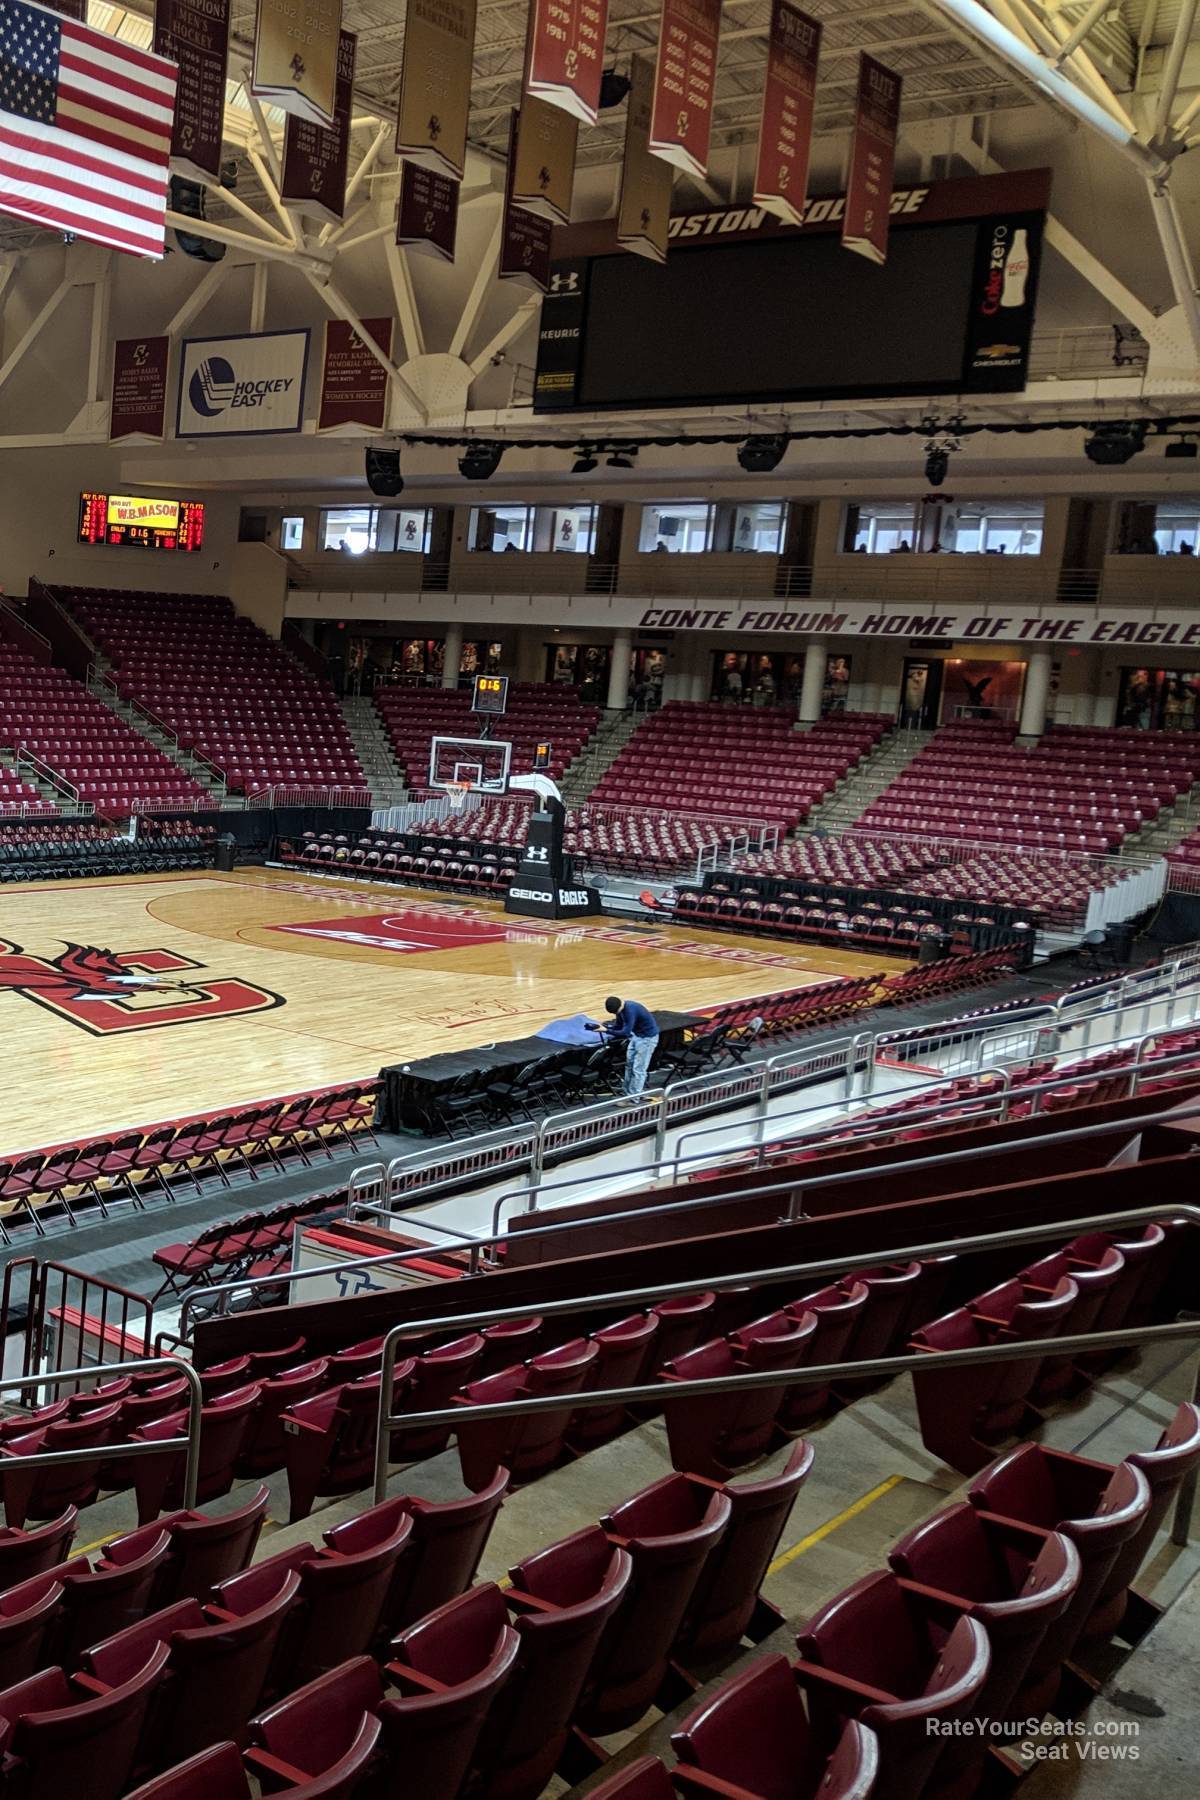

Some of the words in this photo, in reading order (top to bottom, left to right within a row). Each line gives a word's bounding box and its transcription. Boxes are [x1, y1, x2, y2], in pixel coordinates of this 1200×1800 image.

[173, 20, 213, 48] HOCKEY
[546, 22, 566, 41] 1981
[779, 9, 816, 49] SWEET
[871, 68, 895, 99] ELITE
[667, 209, 768, 238] OSTON
[991, 226, 1006, 270] zero
[981, 268, 1001, 315] Coke
[541, 327, 580, 339] KEURIG
[235, 378, 293, 395] HOCKEY
[231, 394, 266, 408] EAST
[638, 609, 732, 630] CONTE
[737, 611, 849, 632] FORUM
[859, 614, 957, 636] HOME
[963, 617, 1012, 638] OF
[1018, 618, 1084, 640] THE
[509, 887, 553, 903] GEICO
[558, 888, 589, 906] EAGLES
[509, 919, 811, 965] COLLEGE
